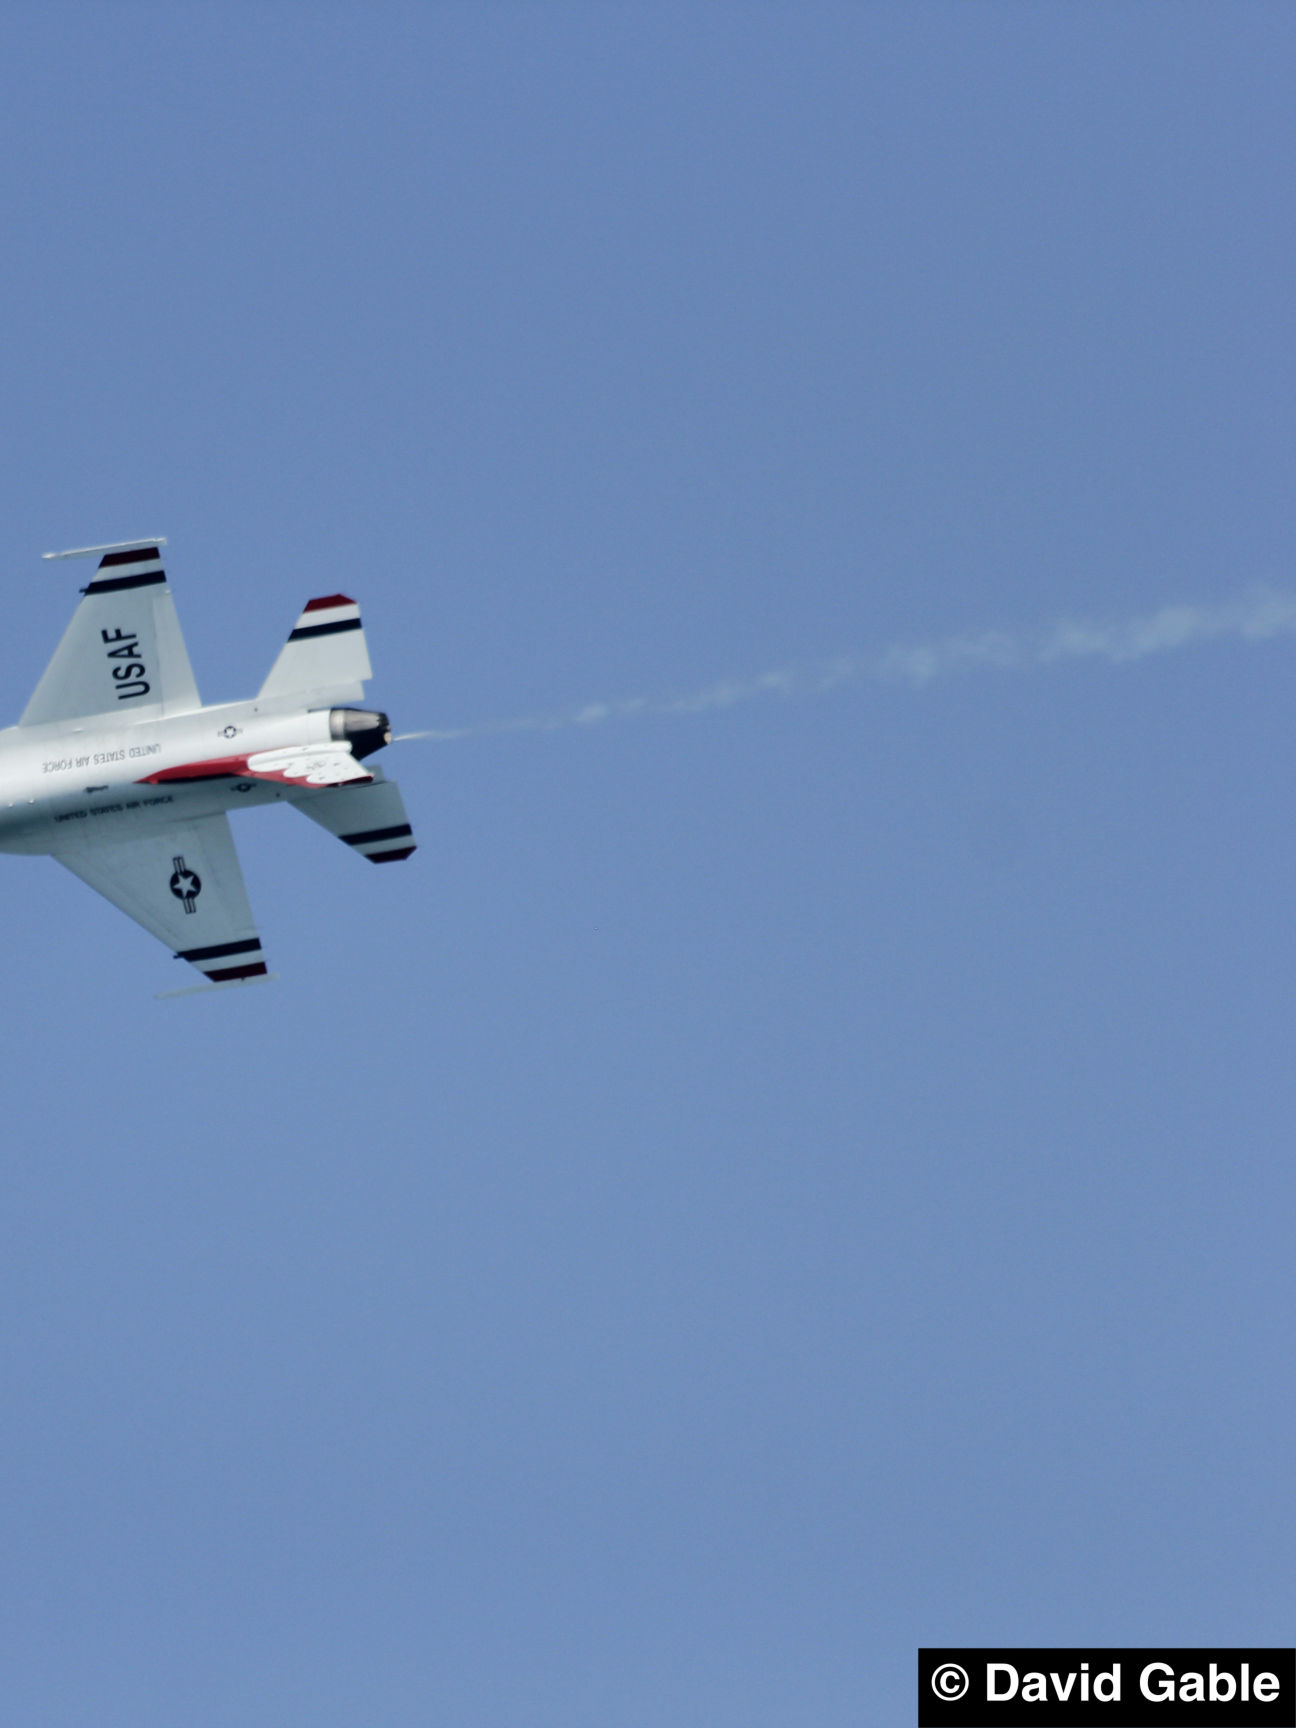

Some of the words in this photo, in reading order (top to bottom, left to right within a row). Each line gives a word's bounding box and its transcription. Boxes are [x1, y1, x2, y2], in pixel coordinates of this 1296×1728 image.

[101, 628, 150, 700] USAF
[93, 749, 125, 765] STATES
[129, 743, 162, 759] UNITED
[41, 758, 73, 773] FORCE
[75, 755, 90, 767] AIR
